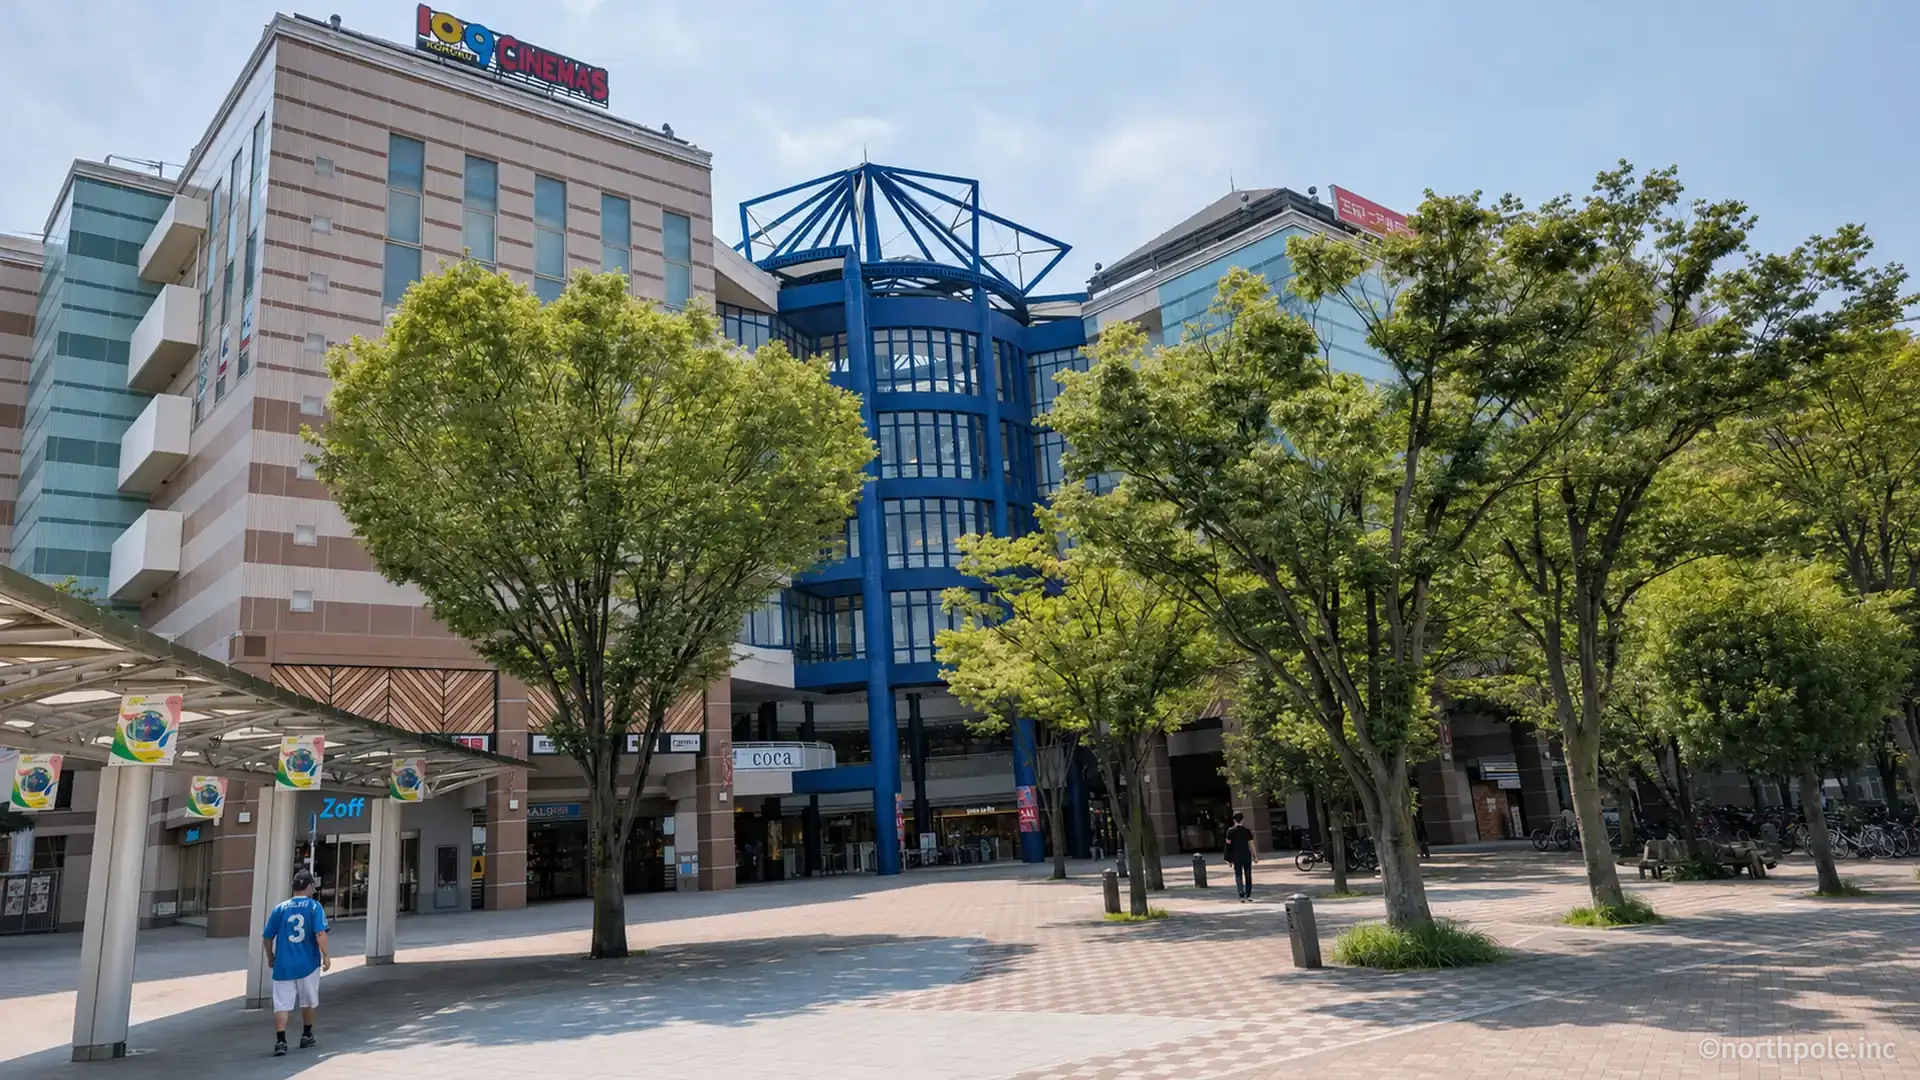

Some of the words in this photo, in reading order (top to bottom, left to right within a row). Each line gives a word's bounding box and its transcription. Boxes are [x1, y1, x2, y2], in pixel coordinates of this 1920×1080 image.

[418, 4, 495, 67] 109
[498, 36, 609, 100] CINEMAS
[752, 751, 793, 767] coca
[320, 796, 365, 819] Zoff
[287, 913, 306, 944] 3
